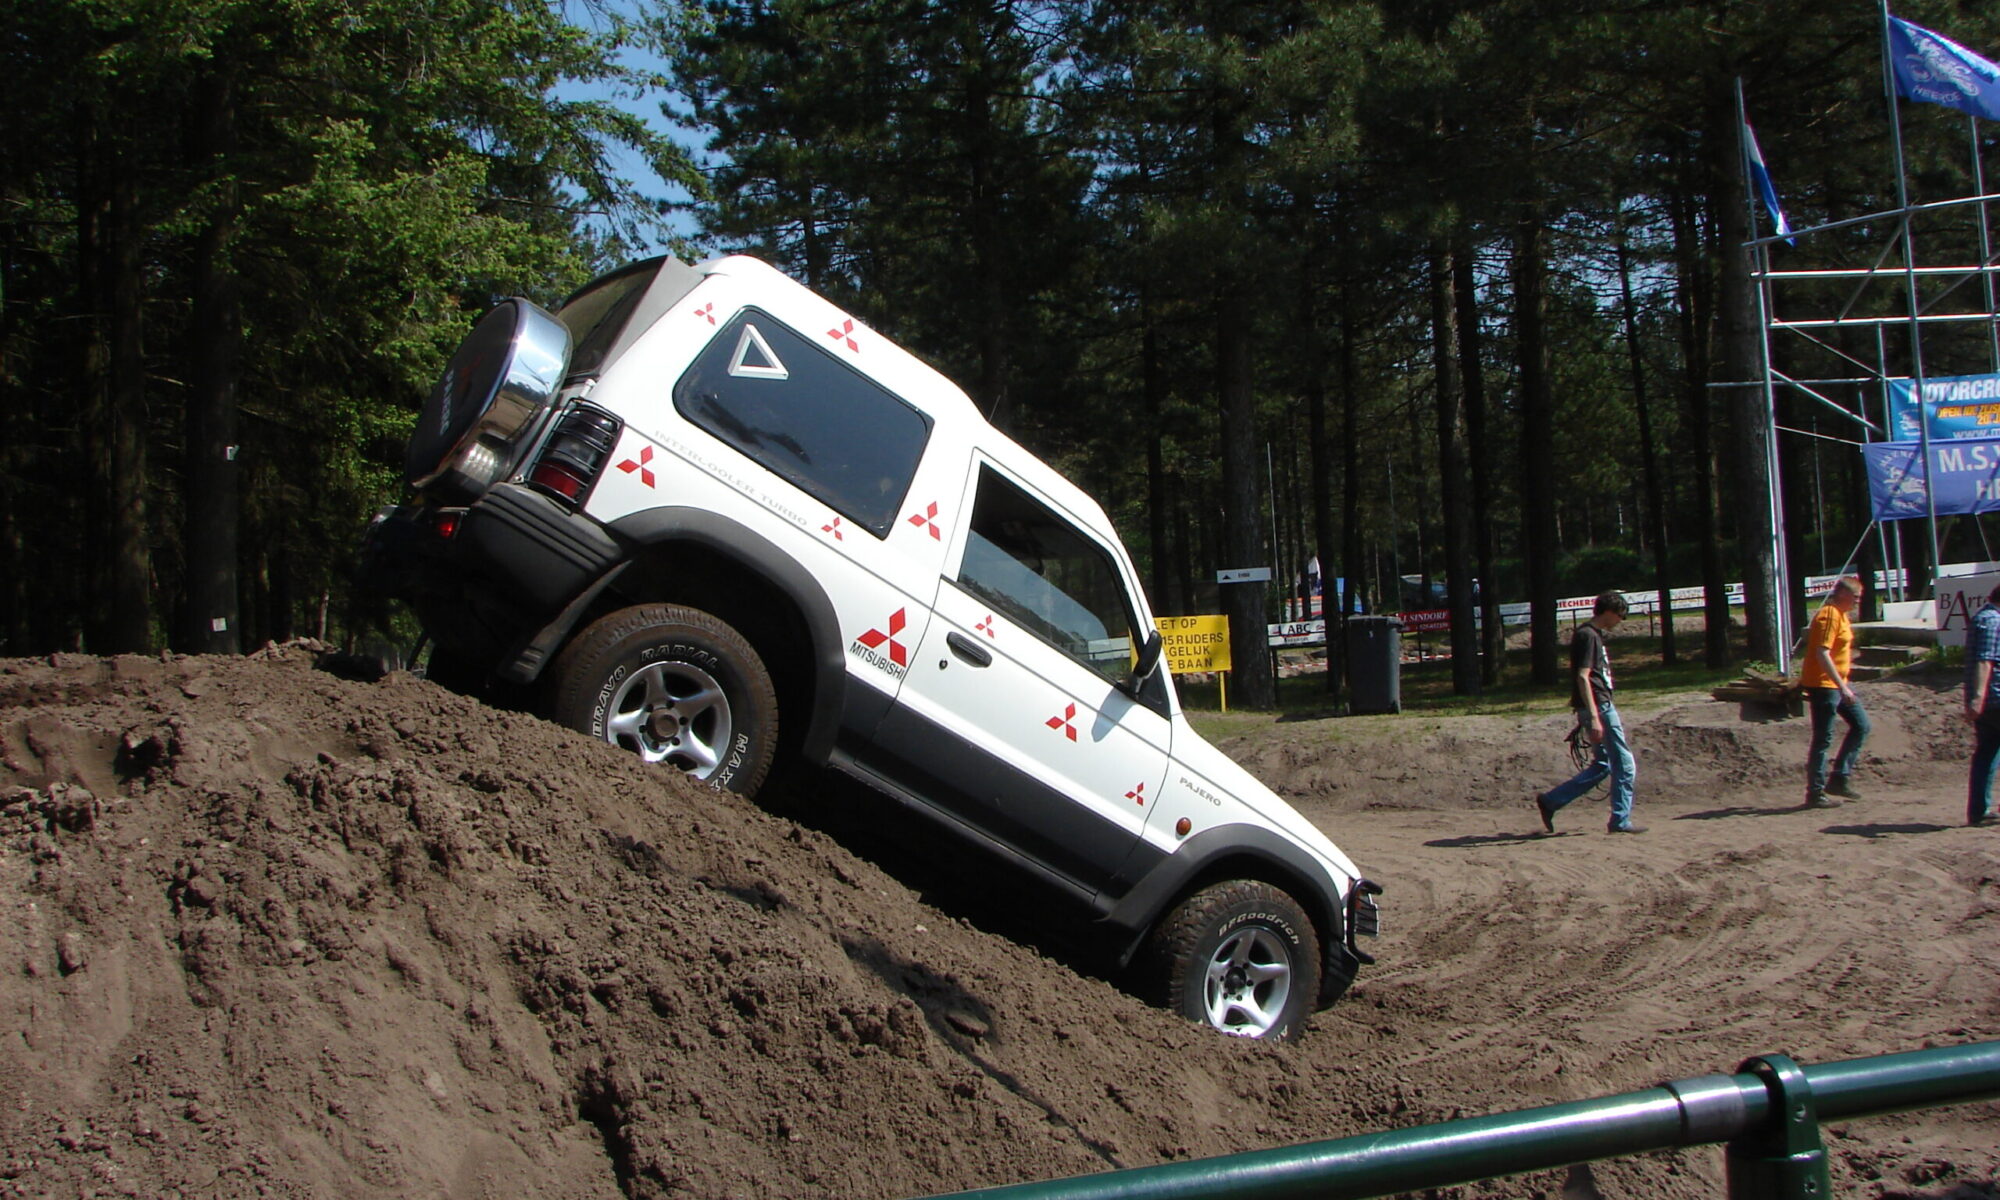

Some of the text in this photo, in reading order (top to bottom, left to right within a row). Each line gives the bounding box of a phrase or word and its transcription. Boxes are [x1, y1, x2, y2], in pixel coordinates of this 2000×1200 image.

[654, 429, 808, 526] INTERCOOLER TURBO
[1180, 617, 1197, 629] OP
[1287, 622, 1310, 635] ABC
[1176, 631, 1224, 645] RIJDERS
[640, 644, 717, 669] RADIAL
[848, 641, 905, 680] MITSUBISHI
[1178, 657, 1213, 670] BAAN
[592, 664, 626, 737] BRAVO
[1179, 776, 1222, 807] PAJERO
[1217, 911, 1299, 945] BFGoodrich
